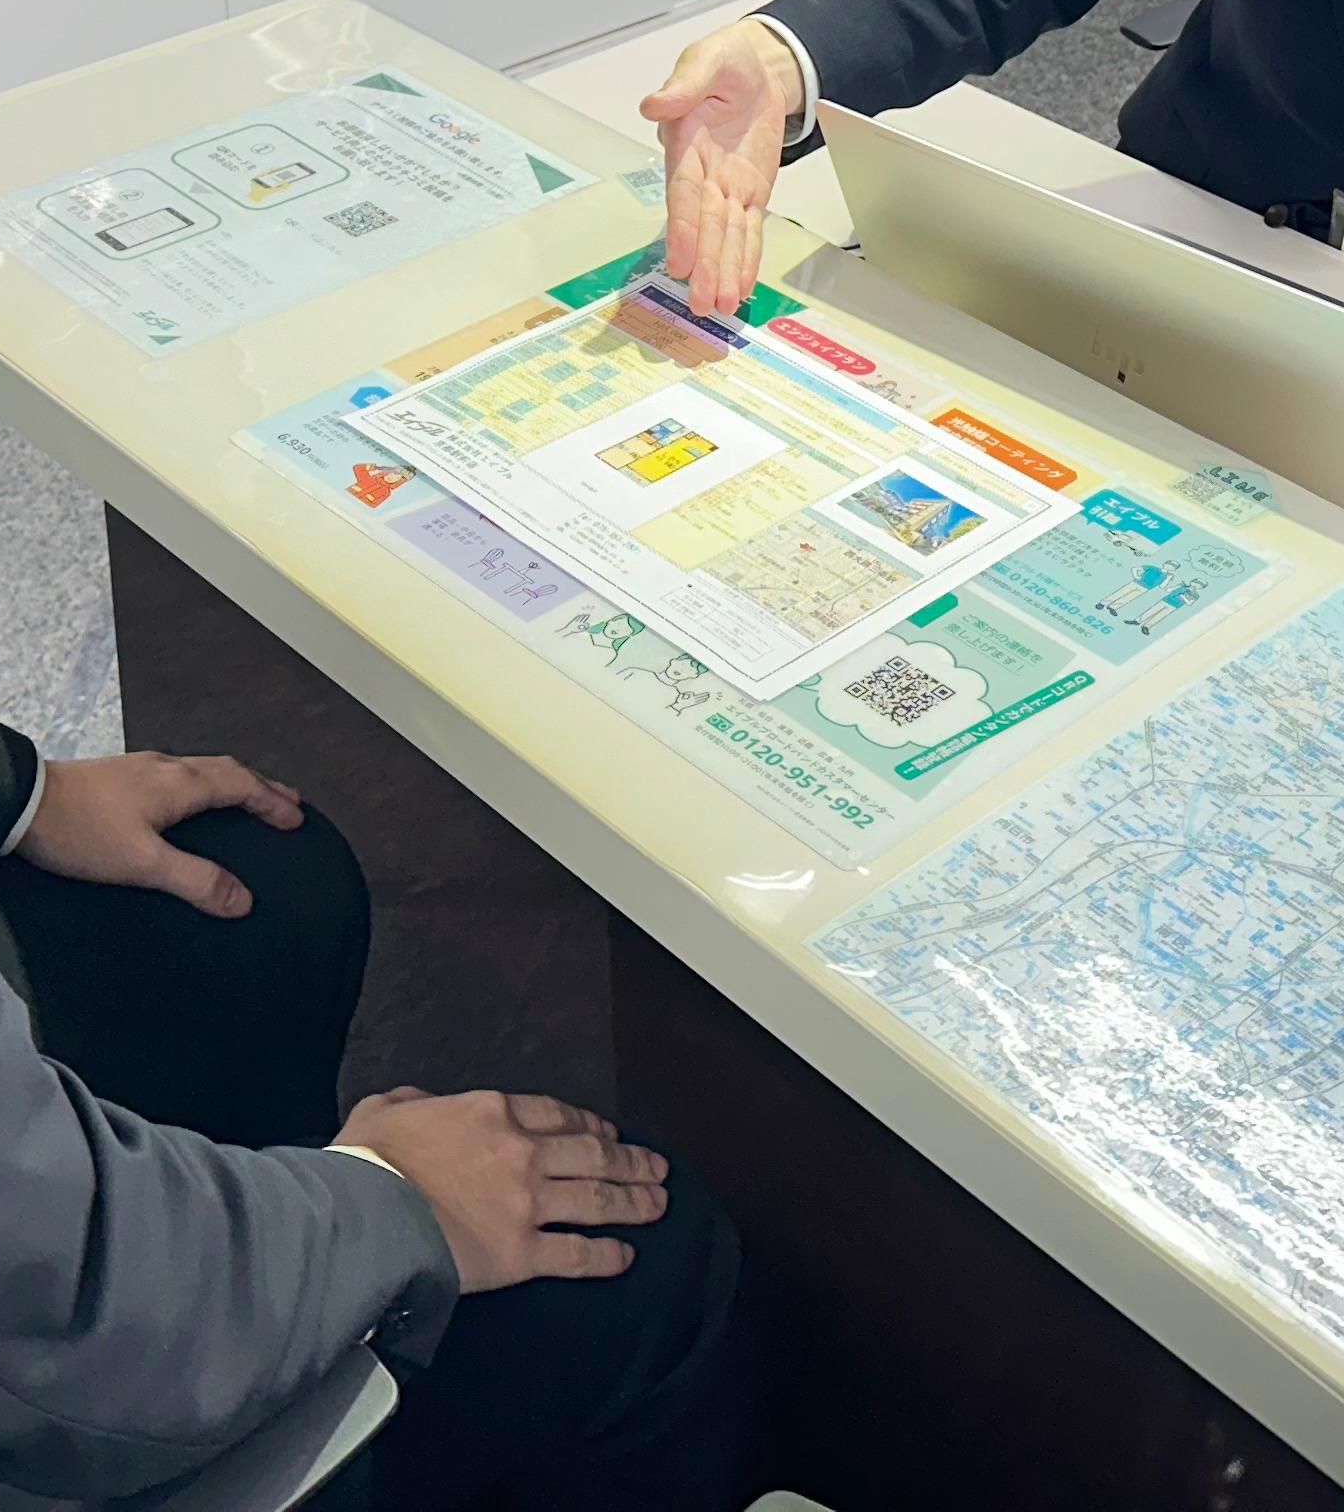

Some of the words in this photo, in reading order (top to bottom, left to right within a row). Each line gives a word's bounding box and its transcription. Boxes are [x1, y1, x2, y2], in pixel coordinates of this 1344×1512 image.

[421, 112, 488, 147] Google
[770, 321, 875, 372] エンジョイプラン
[1085, 505, 1124, 524] 引越
[1098, 497, 1165, 530] エイブル
[1004, 573, 1119, 635] 0120-860-826
[724, 728, 880, 829] 0120-951-992
